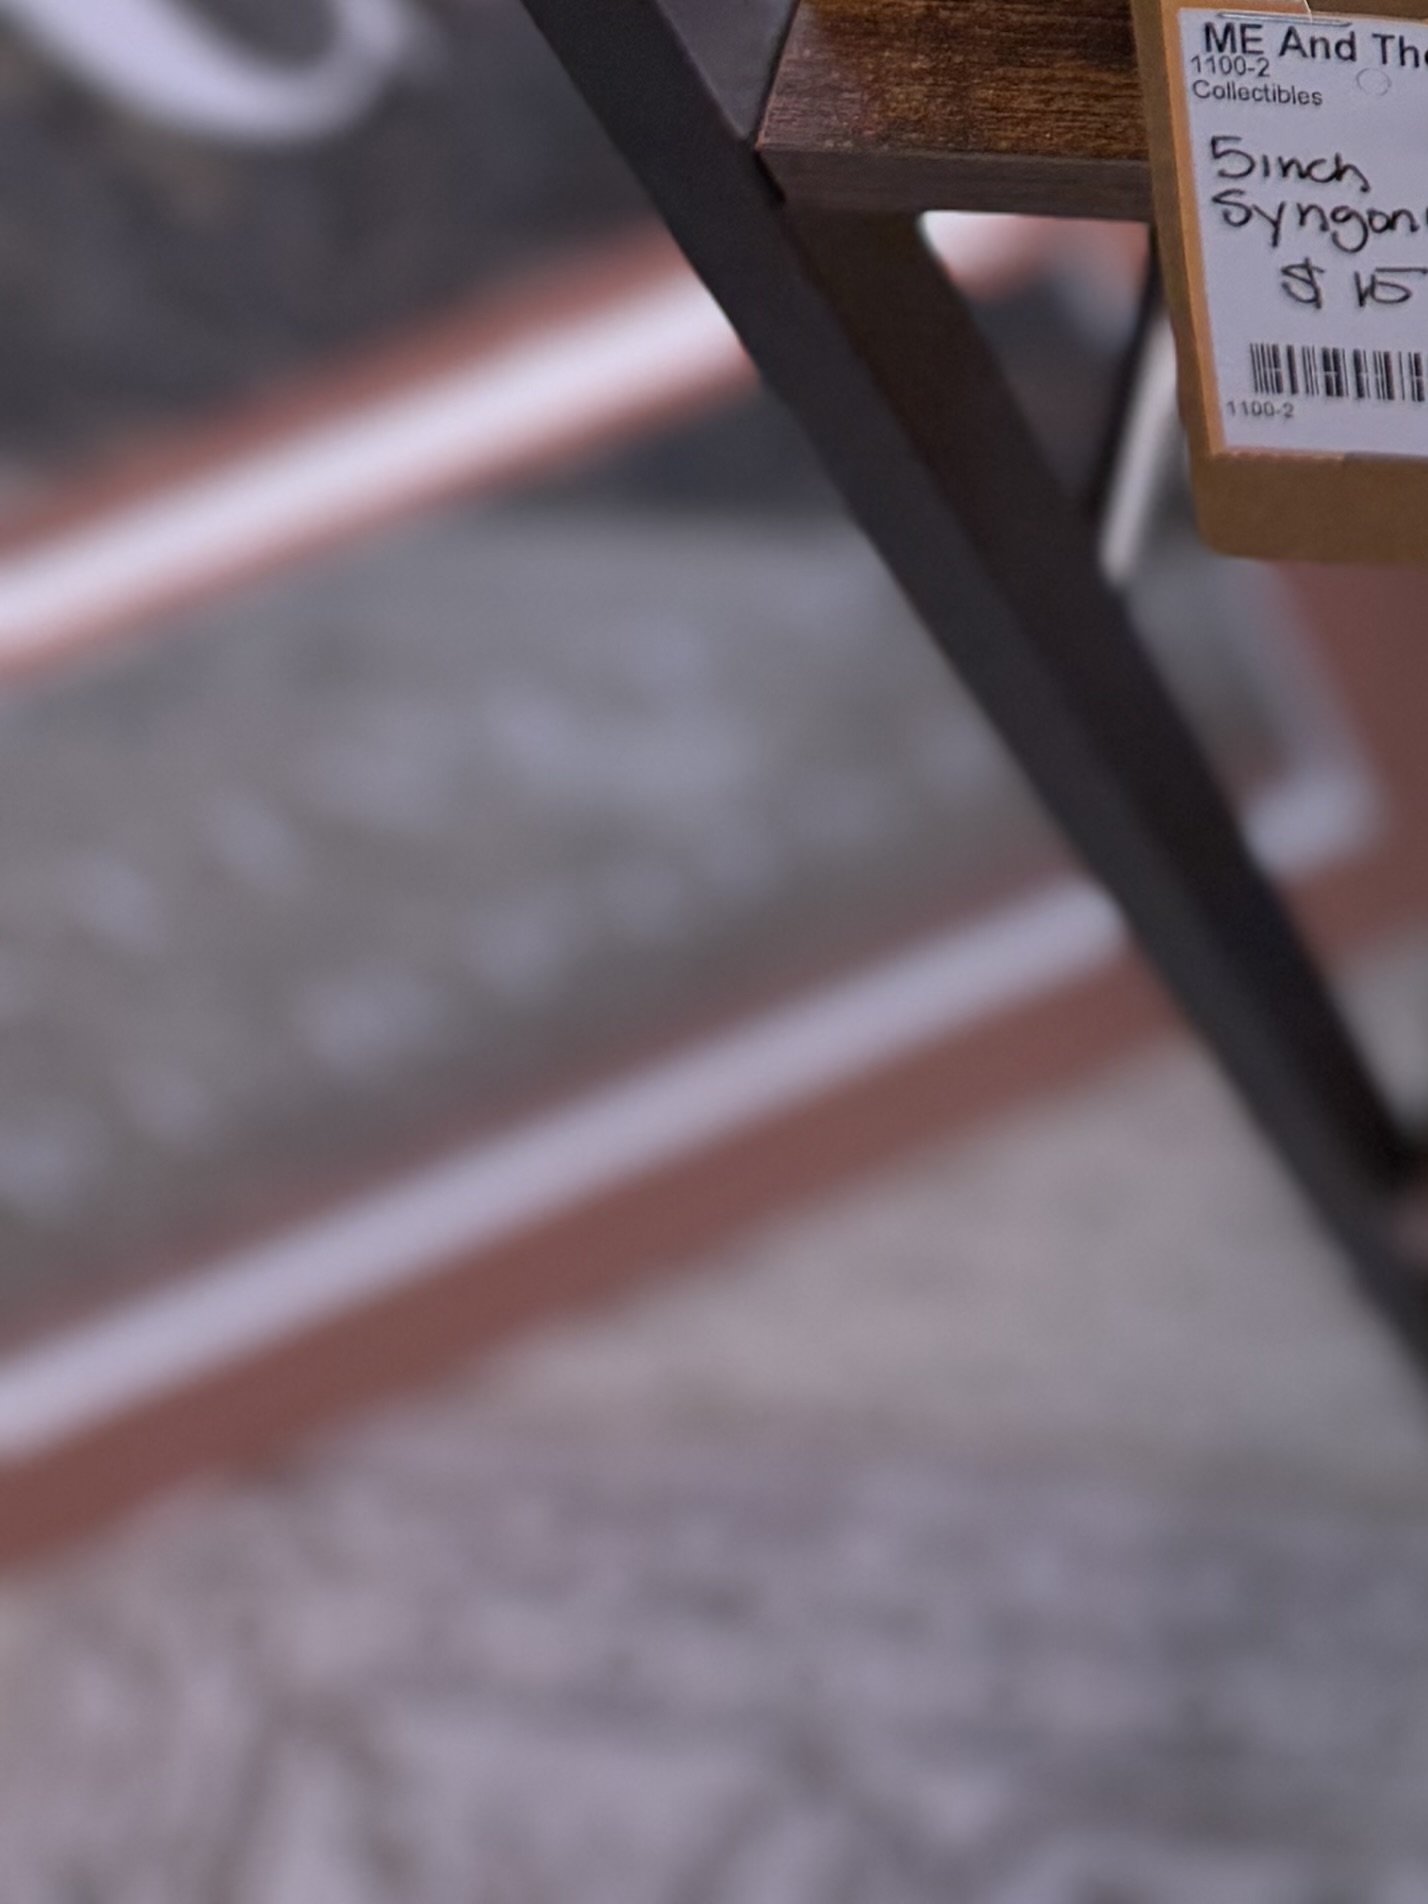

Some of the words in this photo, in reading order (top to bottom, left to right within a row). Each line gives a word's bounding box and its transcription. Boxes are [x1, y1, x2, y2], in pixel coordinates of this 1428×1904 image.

[1204, 22, 1265, 55] ME
[1279, 25, 1358, 62] And
[1190, 55, 1271, 78] 1100-2
[1191, 79, 1324, 107] Collectibles
[1225, 399, 1295, 419] 1100-2
